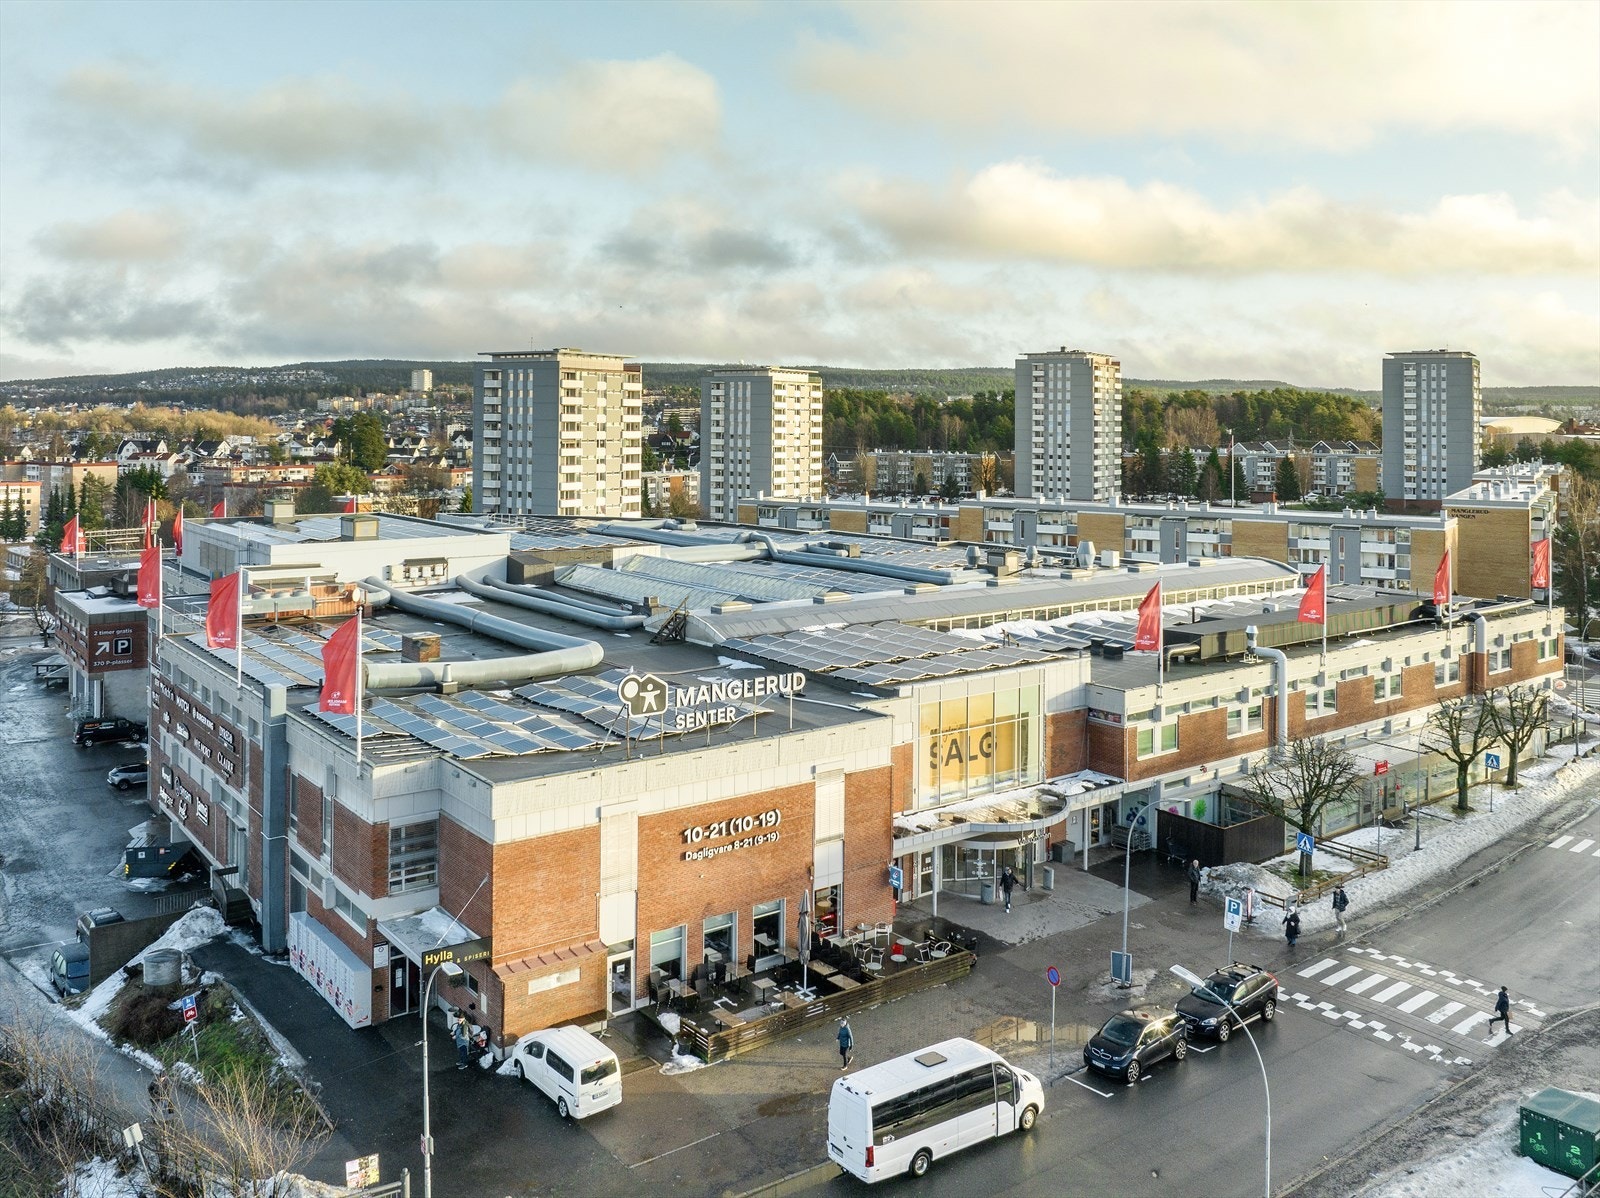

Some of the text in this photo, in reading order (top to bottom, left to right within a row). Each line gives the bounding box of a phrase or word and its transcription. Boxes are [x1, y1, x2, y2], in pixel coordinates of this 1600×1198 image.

[116, 628, 133, 636] gratis
[117, 640, 129, 653] P
[105, 658, 133, 666] P-plasser
[676, 672, 806, 708] MANGLERUD
[675, 706, 736, 730] SENTER
[929, 731, 998, 769] SALG
[684, 808, 781, 844] 10-21 (10-19)
[685, 831, 780, 861] Dagligvare 8-21 (9-19)
[1230, 901, 1238, 912] P
[425, 950, 453, 965] Hylla
[464, 950, 490, 962] SPISERI
[1536, 1132, 1541, 1140] 1
[1570, 1145, 1581, 1155] 2
